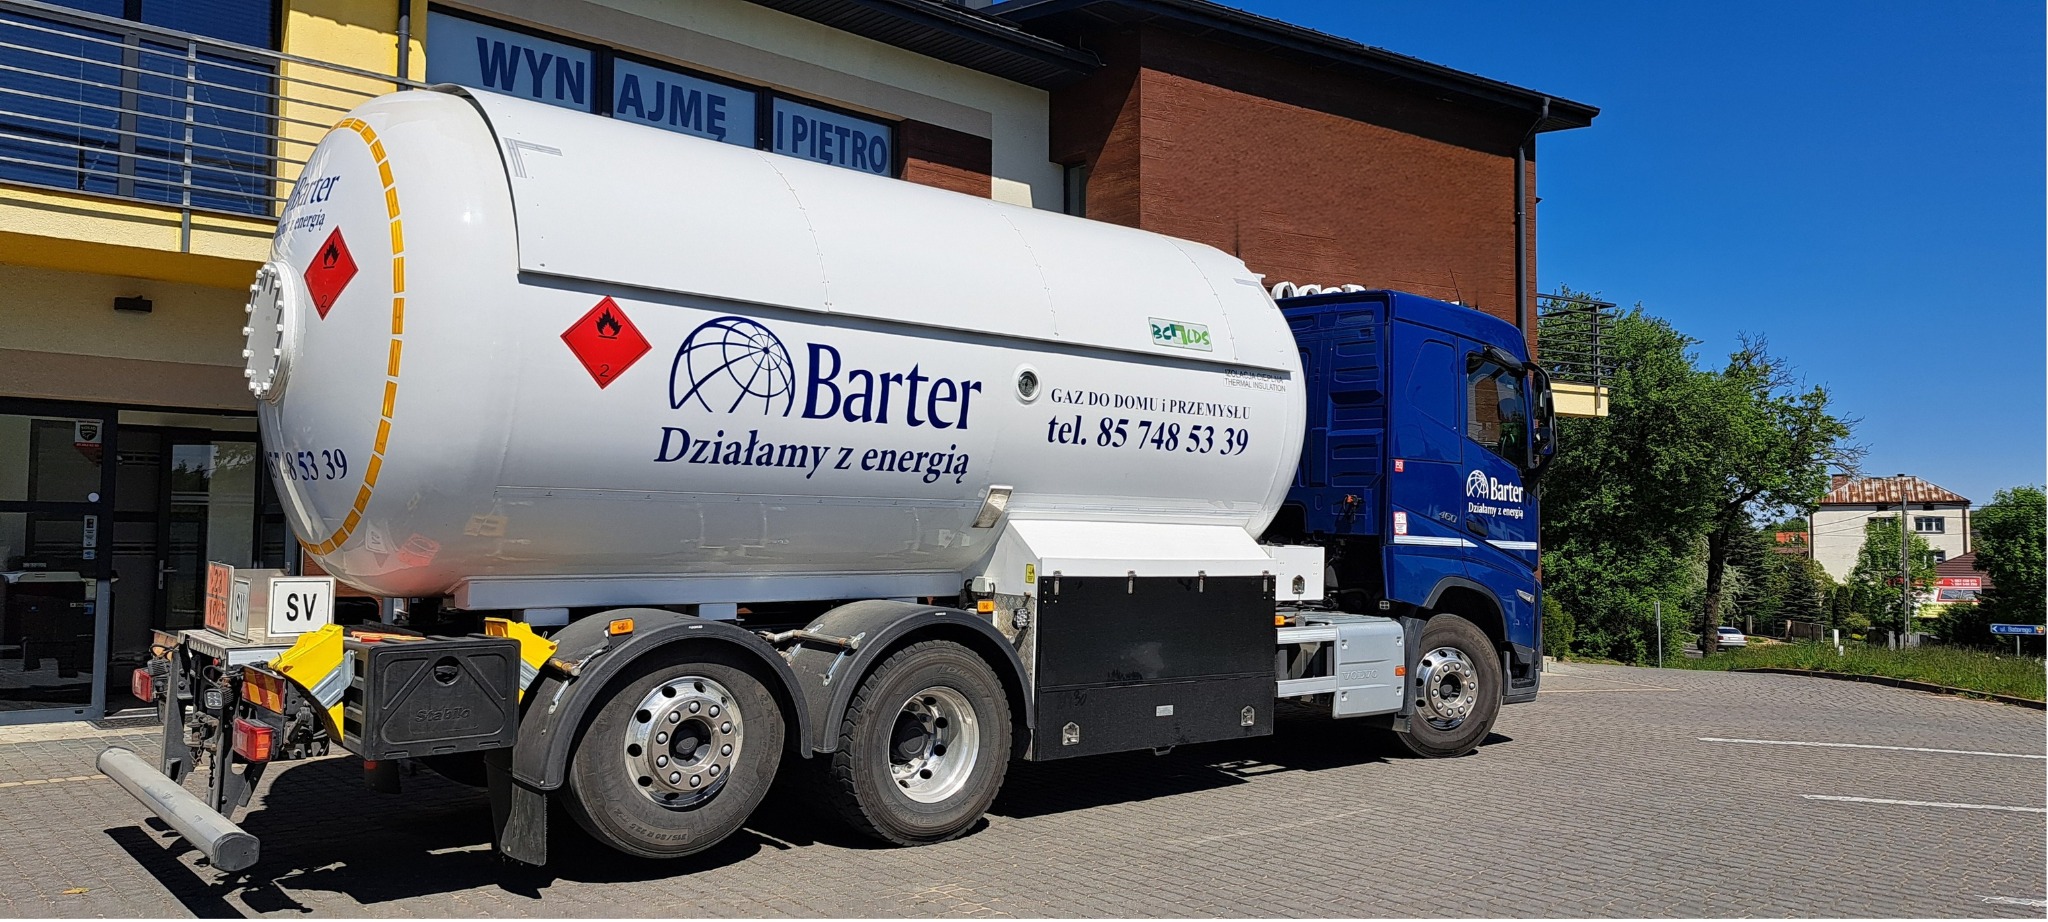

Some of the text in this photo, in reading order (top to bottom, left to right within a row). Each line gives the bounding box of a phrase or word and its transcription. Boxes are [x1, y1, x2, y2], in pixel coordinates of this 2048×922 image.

[776, 110, 785, 151] I
[791, 117, 888, 174] PIĘTRO
[294, 209, 326, 233] energią
[320, 294, 328, 308] 2
[599, 363, 609, 378] 2
[1224, 378, 1286, 392] THERMAL INSULATION
[801, 342, 982, 430] Barter
[1051, 388, 1252, 420] GAZ DO DOMU i PRZEMYSŁU
[1047, 415, 1249, 456] tel. 85 748 53 39
[298, 450, 319, 481] 53
[322, 448, 347, 480] 39
[653, 426, 970, 485] Działamy z energią
[1490, 476, 1524, 503] Barter
[1468, 501, 1497, 518] Działamy
[1502, 506, 1524, 520] energią
[285, 592, 318, 622] SV
